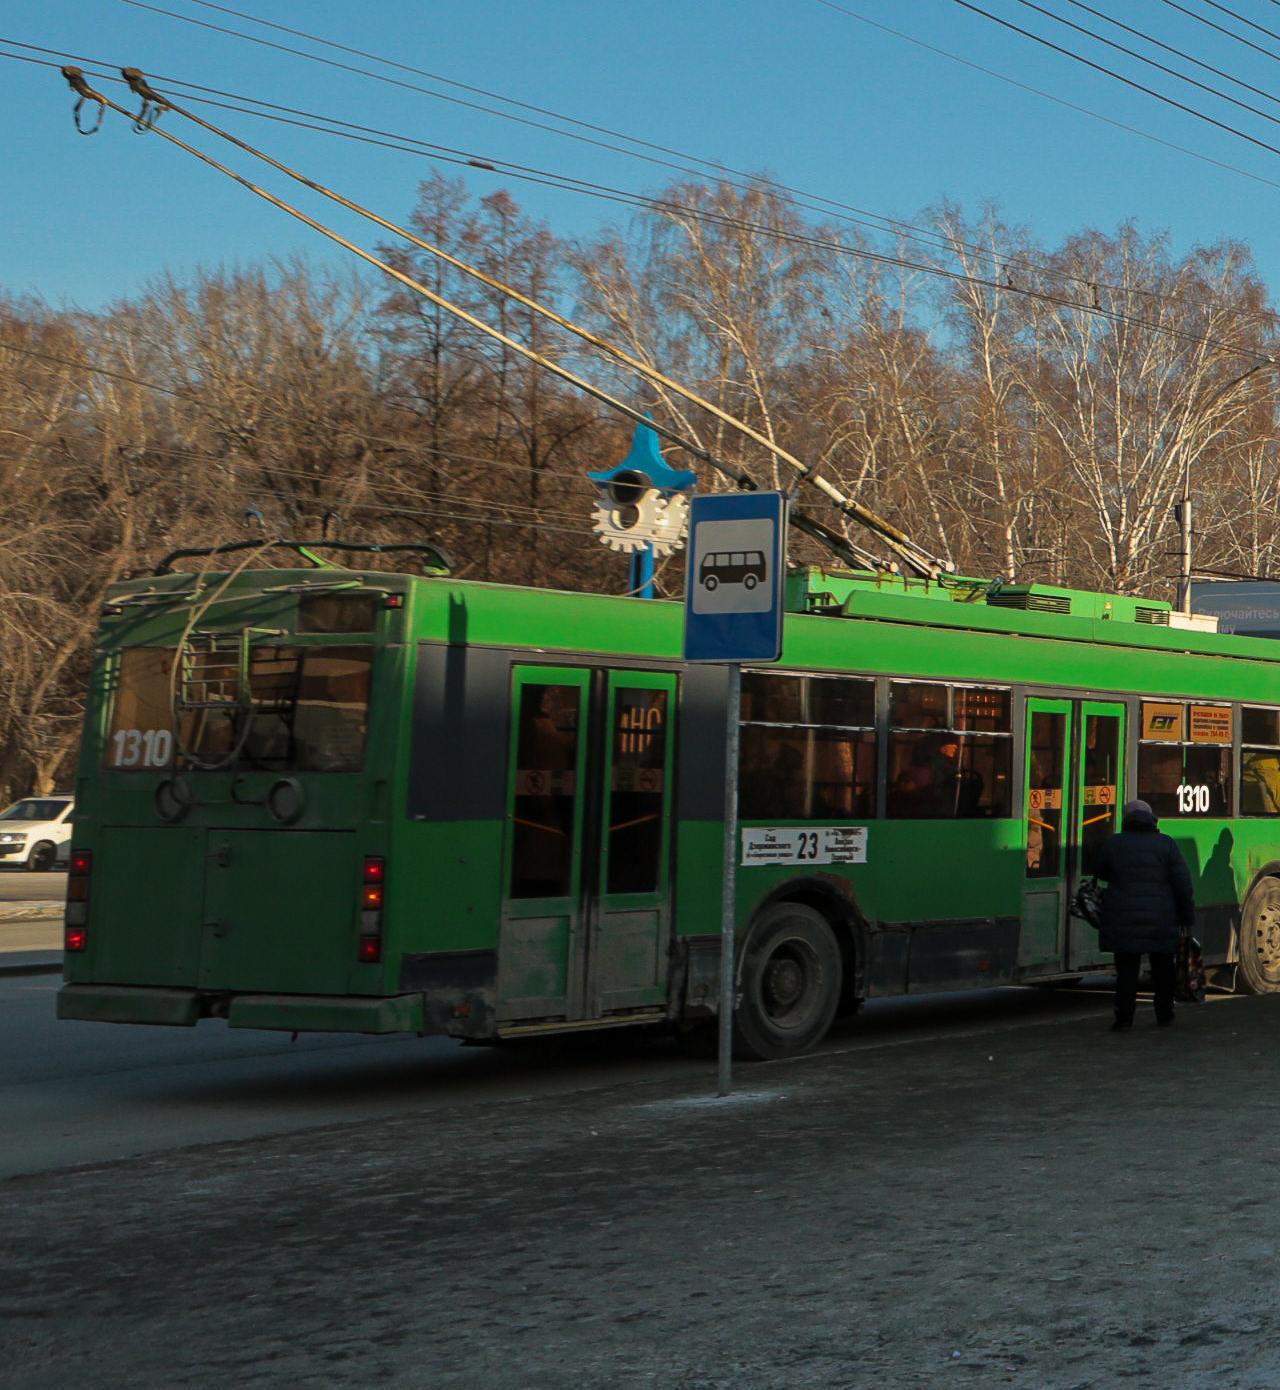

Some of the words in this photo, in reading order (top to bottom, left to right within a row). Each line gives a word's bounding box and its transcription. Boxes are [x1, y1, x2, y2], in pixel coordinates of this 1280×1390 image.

[113, 729, 172, 767] 1310
[1176, 784, 1210, 812] 1310
[797, 832, 818, 859] 23
